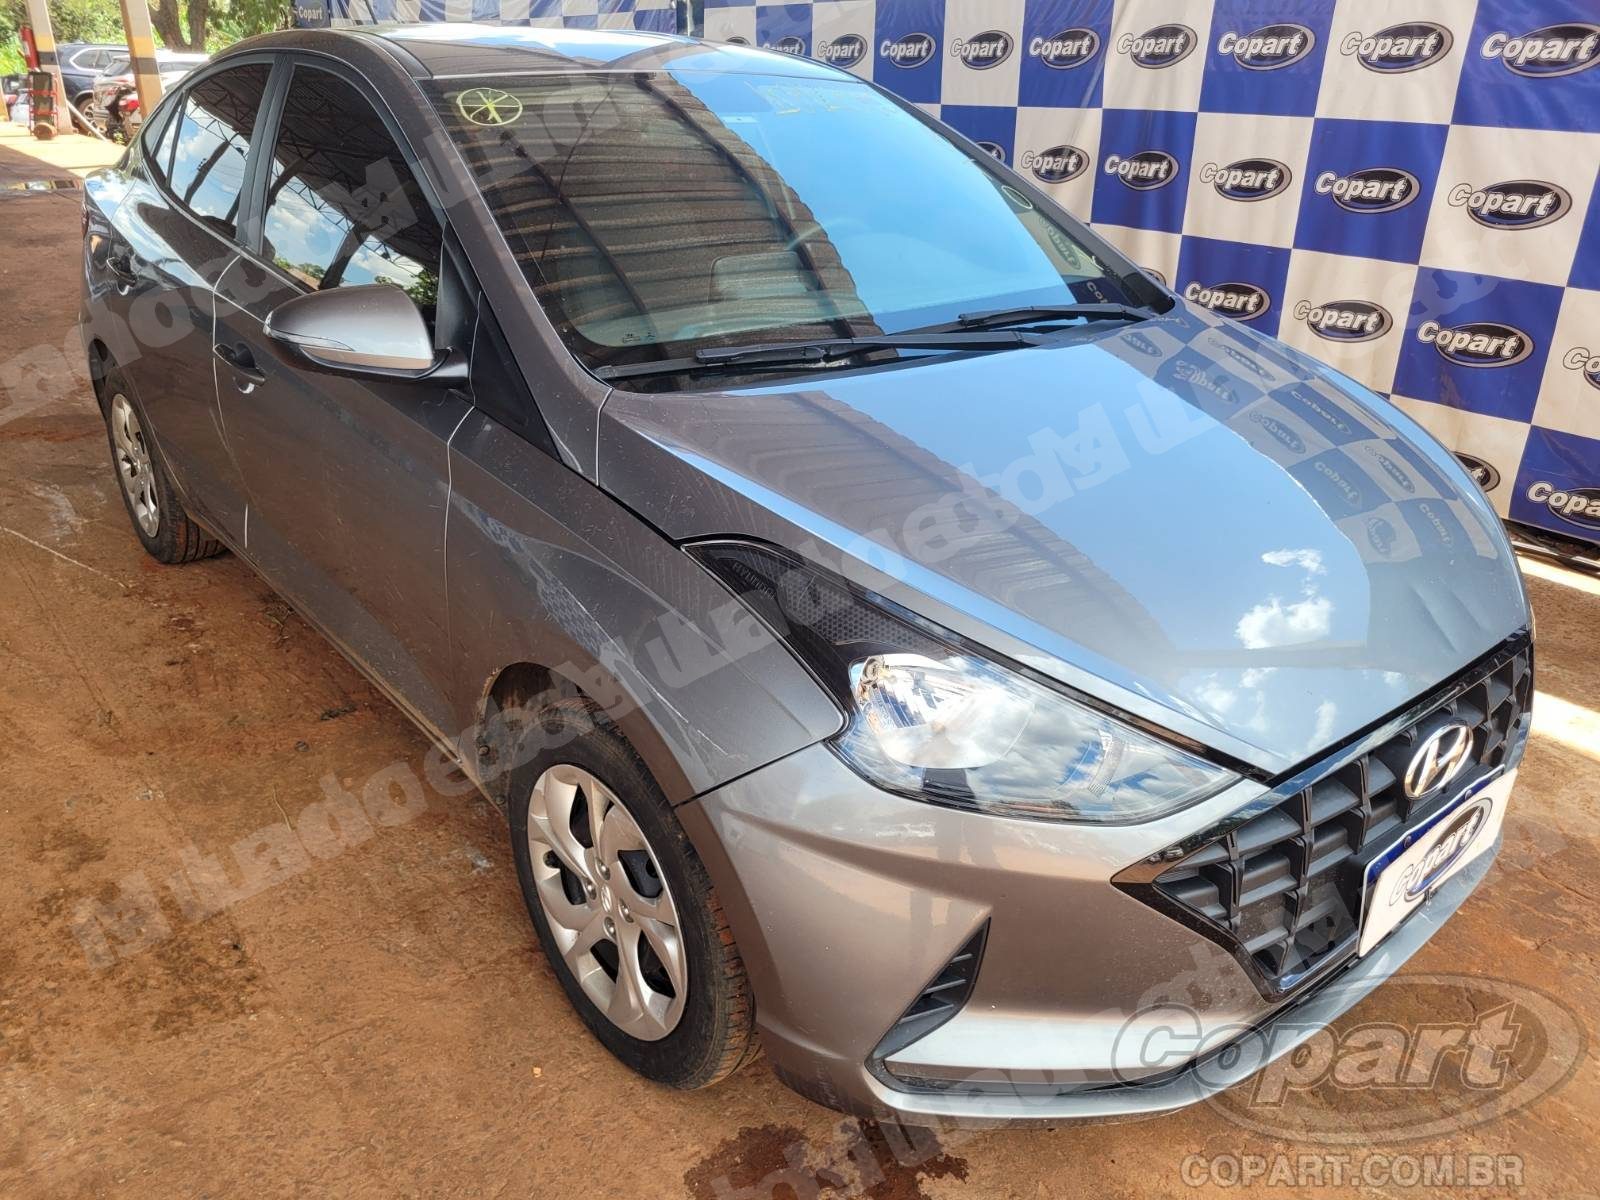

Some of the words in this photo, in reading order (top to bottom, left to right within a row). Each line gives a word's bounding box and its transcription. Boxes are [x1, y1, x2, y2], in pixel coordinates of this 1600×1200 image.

[298, 6, 323, 21] Copart
[817, 40, 861, 60] Copart
[880, 38, 929, 61] Copart
[951, 37, 1004, 61] Copart
[1029, 35, 1091, 60] Copart
[1117, 31, 1186, 58] Copart
[1218, 31, 1303, 59] Copart
[1340, 29, 1440, 62] Copart
[1481, 30, 1599, 66] Copart
[1021, 150, 1079, 175] Copart
[1104, 155, 1170, 180] Copart
[1200, 163, 1279, 190] Copart
[1314, 170, 1408, 201] Copart
[1448, 183, 1556, 217] Copart
[1184, 281, 1262, 313] Copart
[1293, 300, 1381, 332] Copart
[1417, 321, 1520, 358] Copart
[1527, 481, 1600, 516] Copa
[1389, 806, 1482, 906] Copart
